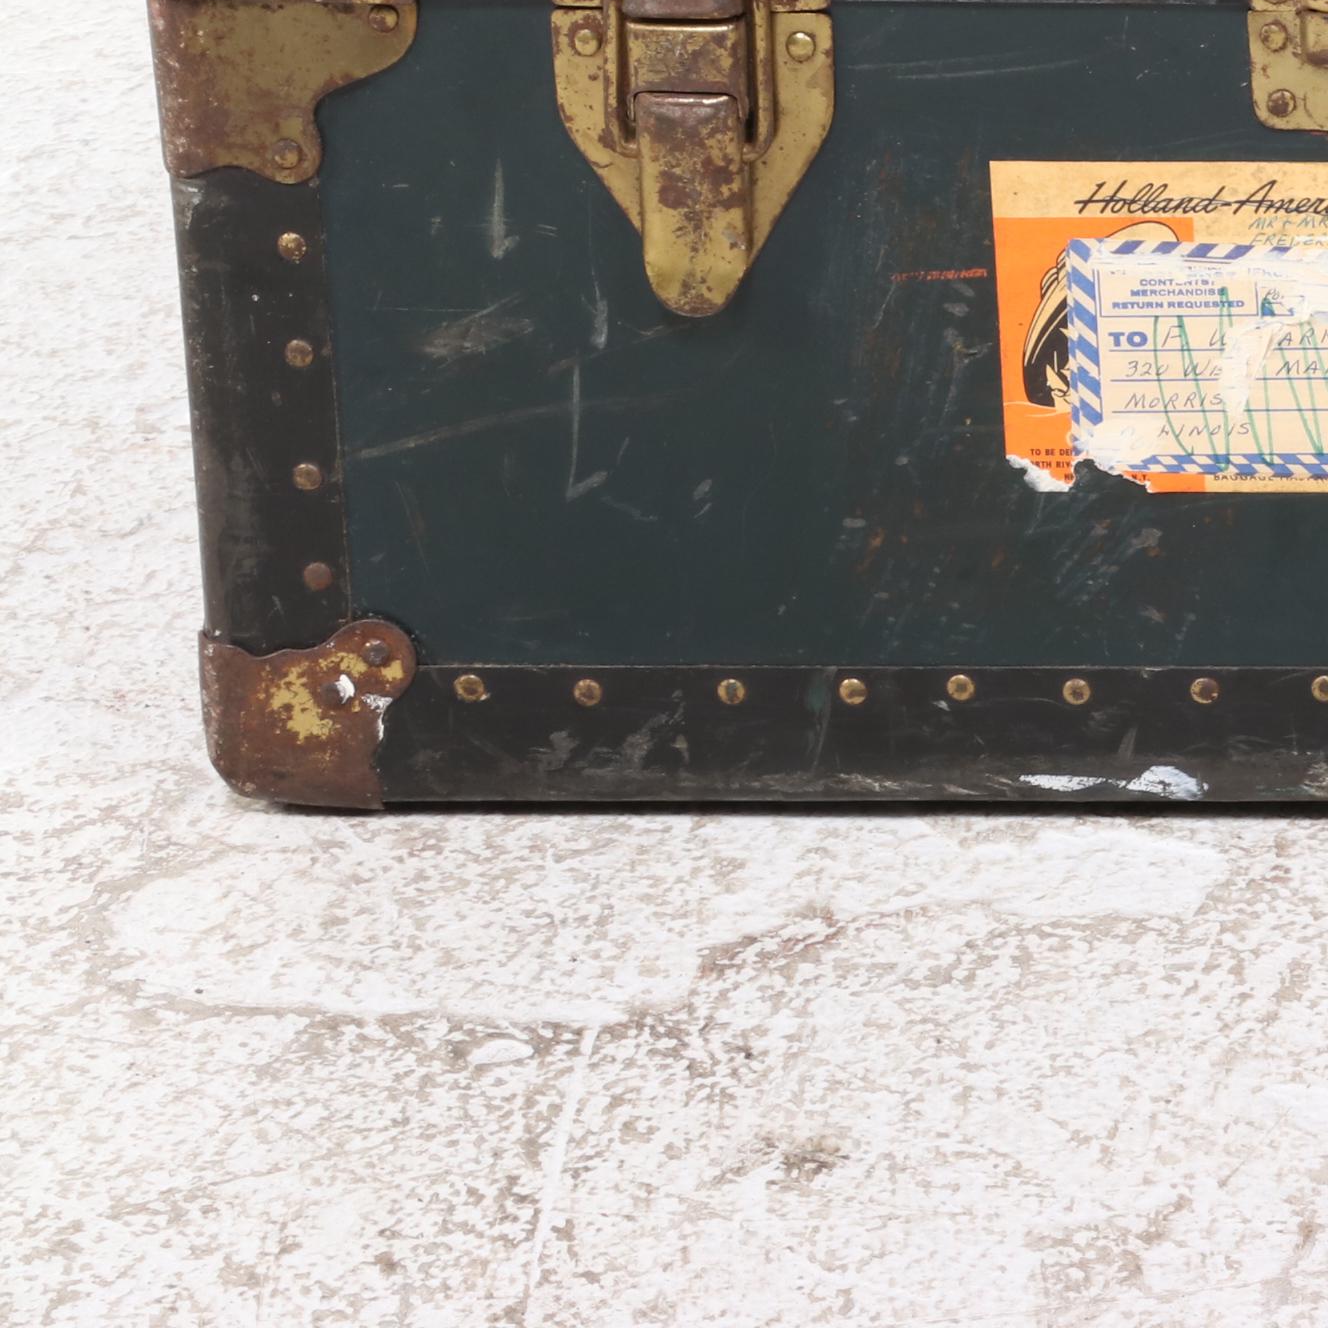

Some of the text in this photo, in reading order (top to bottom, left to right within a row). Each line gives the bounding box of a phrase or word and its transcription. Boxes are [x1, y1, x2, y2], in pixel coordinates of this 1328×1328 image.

[1130, 288, 1226, 297] MERCHANDISE
[1111, 300, 1245, 310] RETURN REQUESTED
[1108, 331, 1148, 348] TO
[1125, 360, 1169, 378] 320
